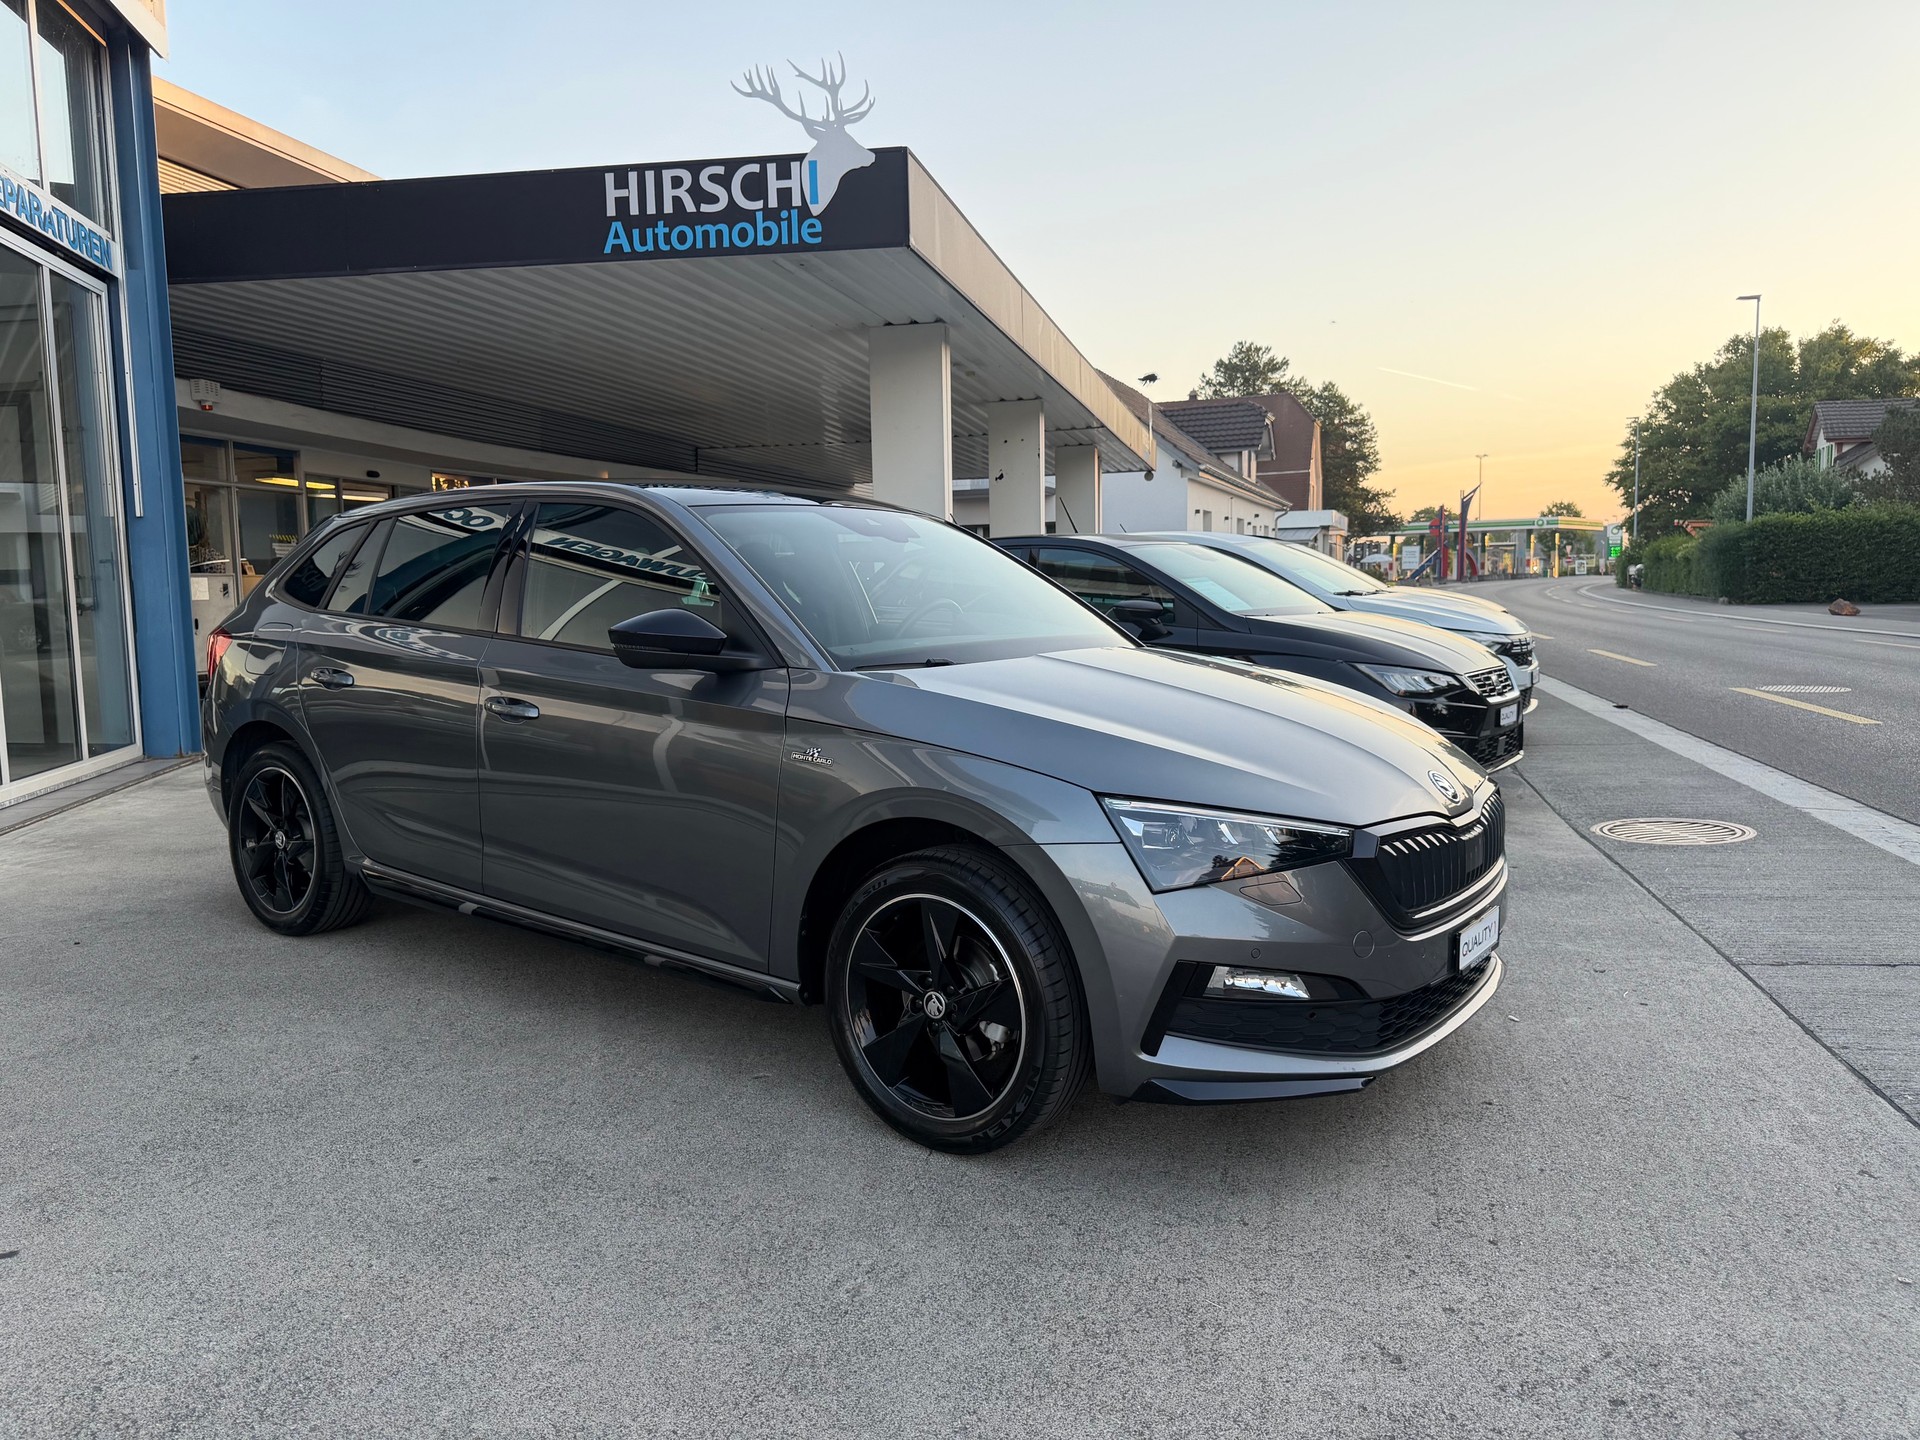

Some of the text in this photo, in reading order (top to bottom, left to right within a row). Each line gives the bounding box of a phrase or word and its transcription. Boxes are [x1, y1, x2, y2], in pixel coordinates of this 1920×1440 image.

[604, 160, 819, 217] HIRSCHI
[603, 208, 823, 254] Automobile
[971, 1065, 1041, 1143] NEXEN
